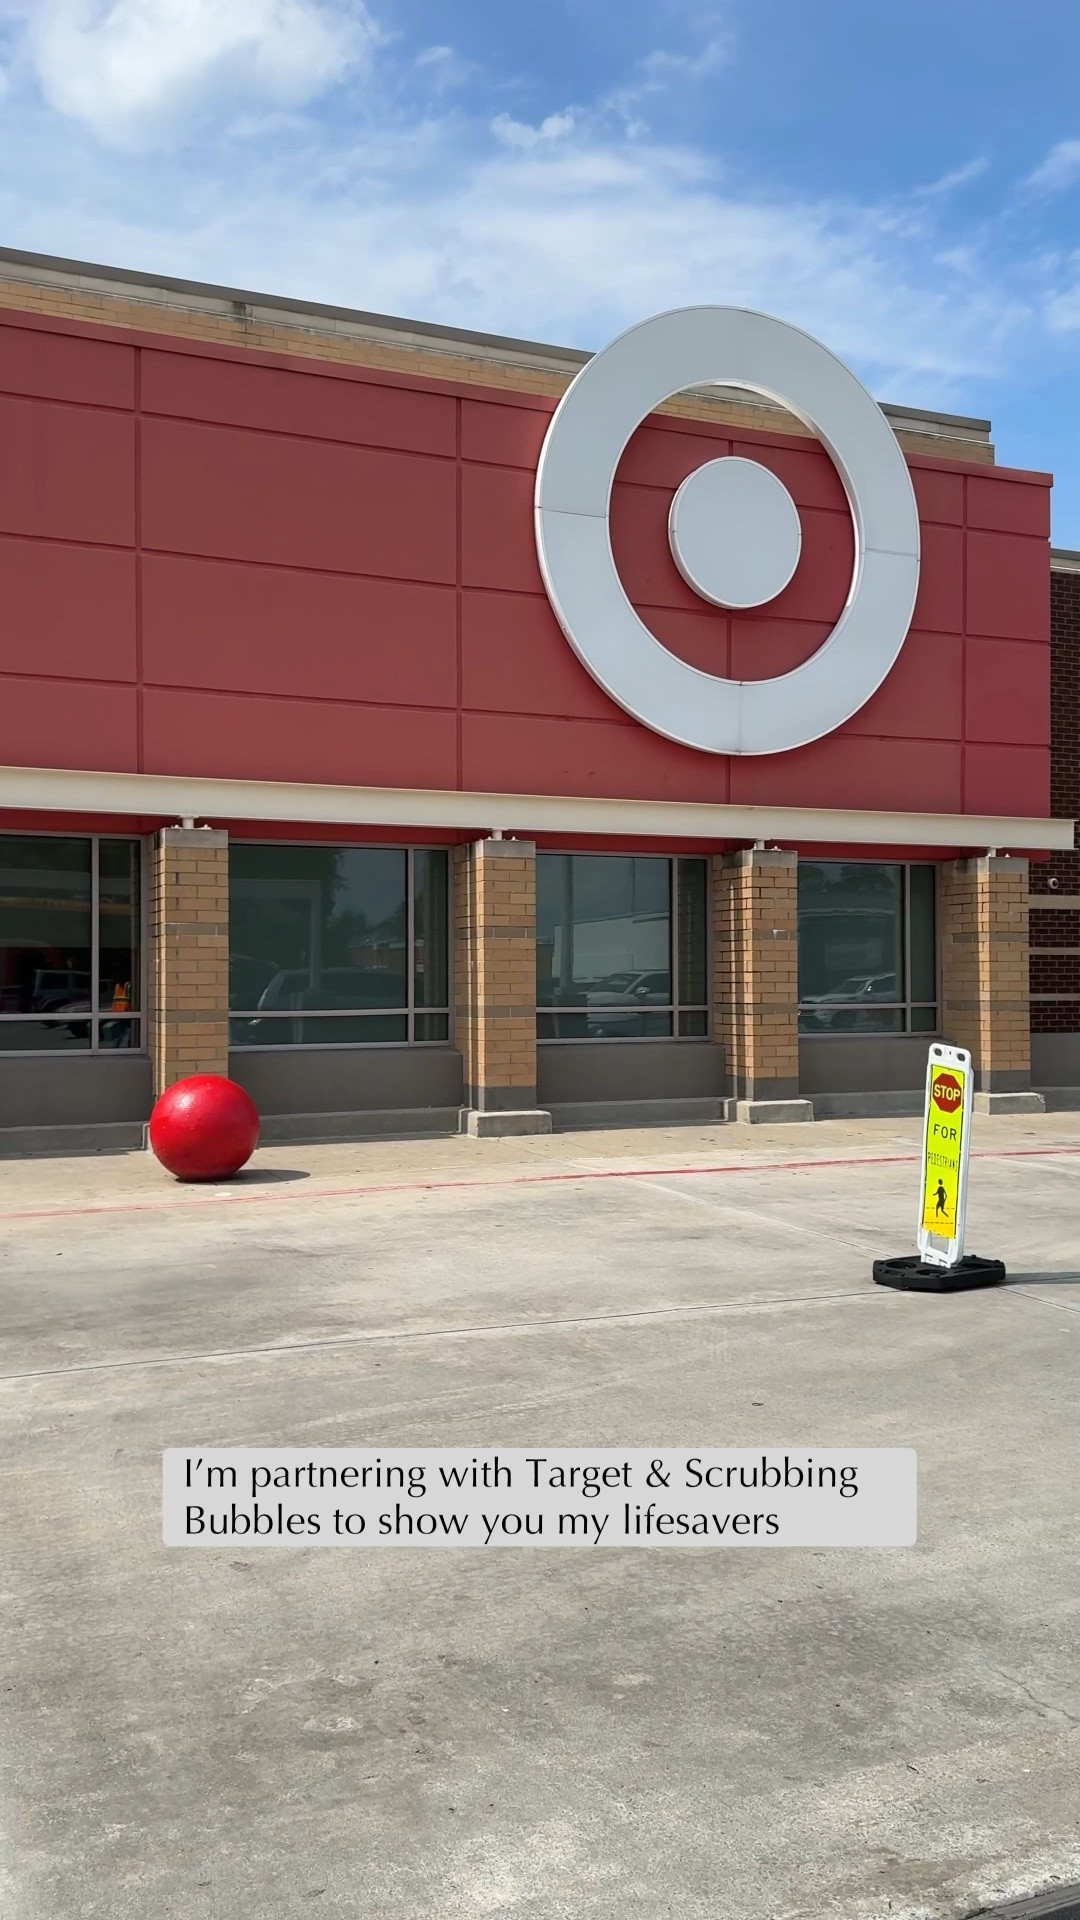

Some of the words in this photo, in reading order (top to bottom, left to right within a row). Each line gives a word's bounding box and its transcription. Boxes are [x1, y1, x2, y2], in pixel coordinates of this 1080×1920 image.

[933, 1083, 960, 1102] STOP
[933, 1123, 957, 1141] FOR
[927, 1151, 959, 1172] PEDESTRIANS
